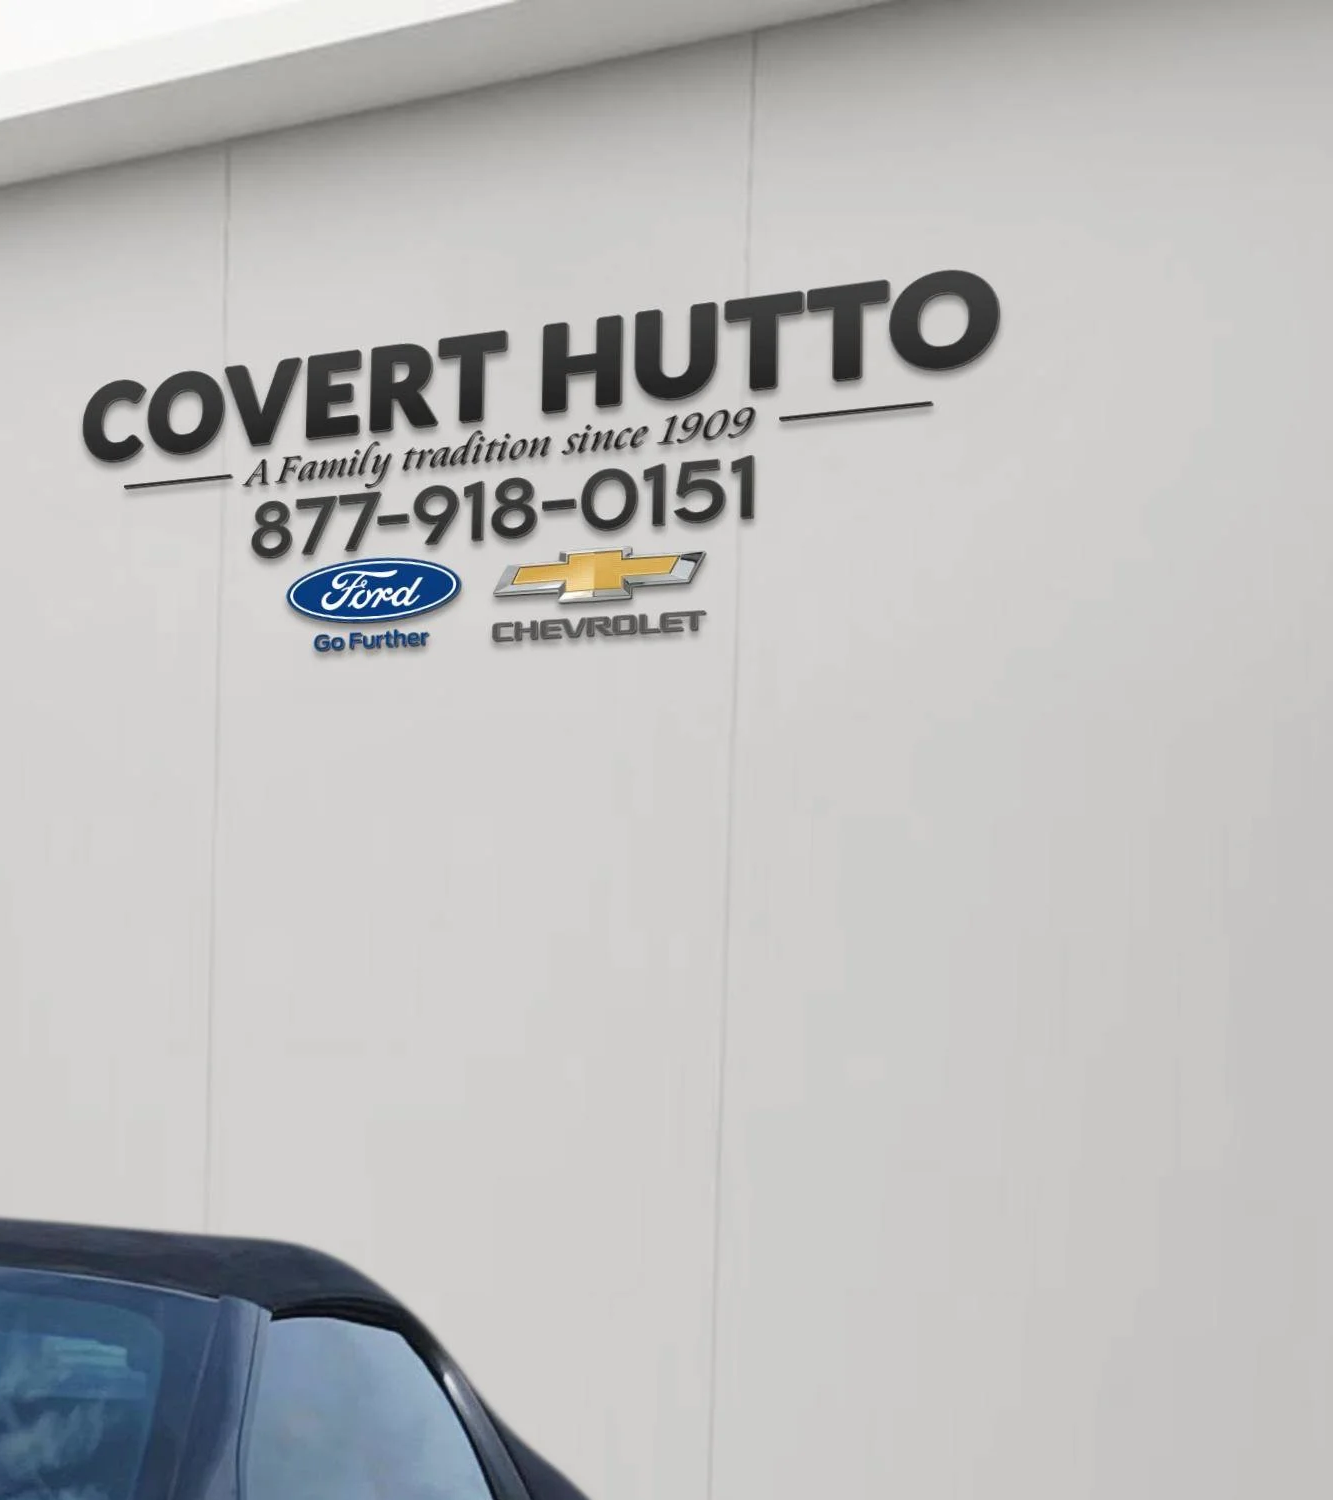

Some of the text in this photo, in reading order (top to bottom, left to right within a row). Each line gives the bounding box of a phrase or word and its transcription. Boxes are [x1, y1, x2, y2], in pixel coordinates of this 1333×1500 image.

[82, 269, 1001, 464] COVERT HUTTO
[242, 406, 756, 489] A Family tradition since 1909
[251, 454, 756, 560] 877-918-0151
[320, 569, 423, 612] Ford
[313, 628, 430, 653] Go Further
[491, 610, 707, 643] CHEVROLET
